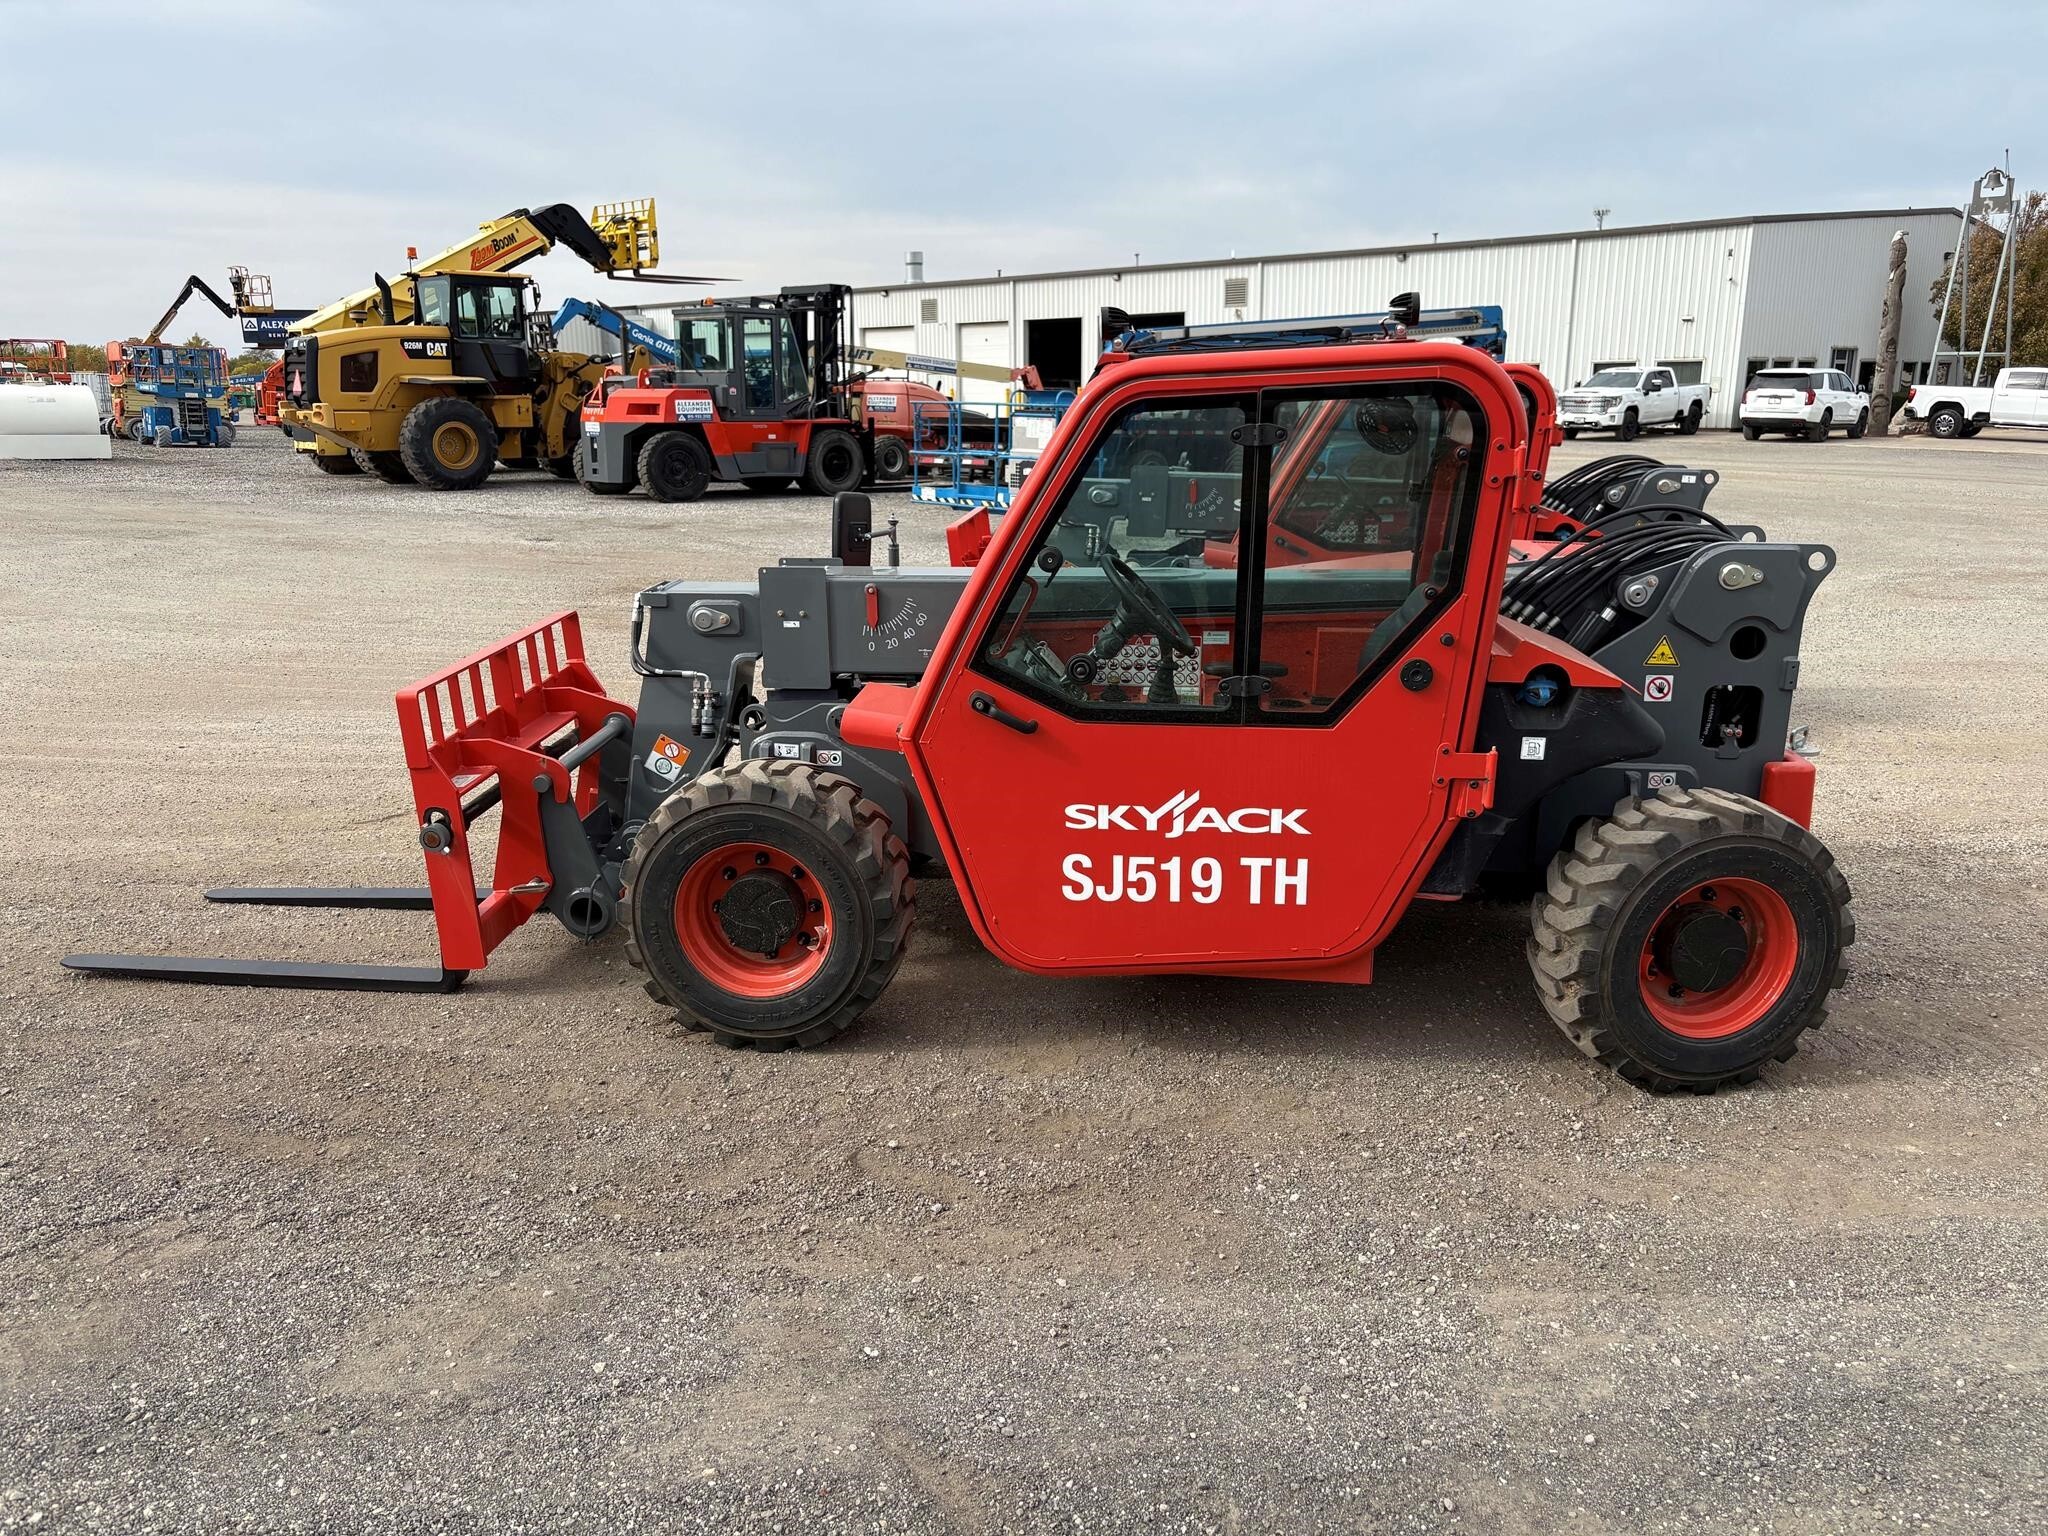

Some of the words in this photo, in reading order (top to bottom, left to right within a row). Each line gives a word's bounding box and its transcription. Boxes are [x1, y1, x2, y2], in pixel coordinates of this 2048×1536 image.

[403, 341, 423, 350] 926M
[426, 341, 448, 357] CAT
[631, 328, 654, 346] Genie
[868, 641, 876, 652] 0
[885, 637, 899, 650] 20
[903, 627, 916, 640] 40
[915, 612, 928, 627] 60
[1064, 789, 1312, 839] SKYJACK
[1061, 853, 1223, 904] SJ519
[1240, 857, 1309, 905] TH
